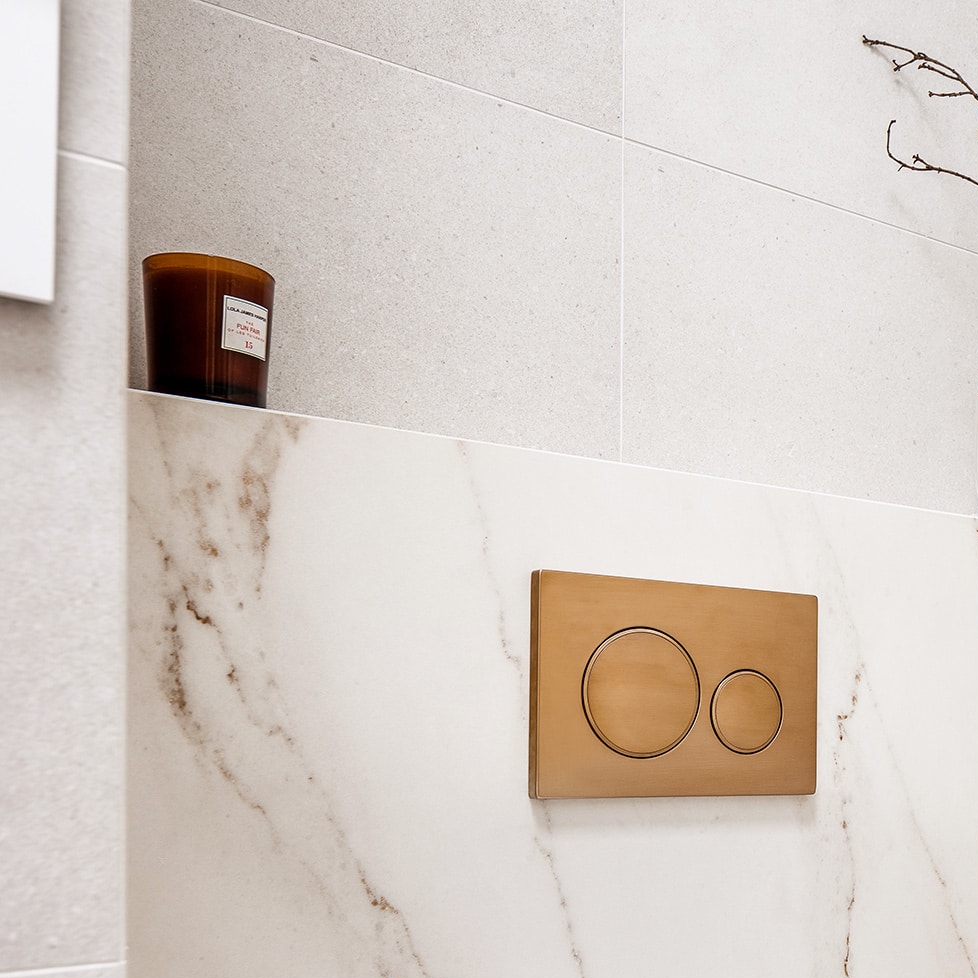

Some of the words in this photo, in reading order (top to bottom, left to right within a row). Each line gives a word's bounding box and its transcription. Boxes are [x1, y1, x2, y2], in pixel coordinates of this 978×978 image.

[236, 323, 249, 331] FUN
[249, 326, 261, 335] FAIR
[245, 340, 253, 350] 15
